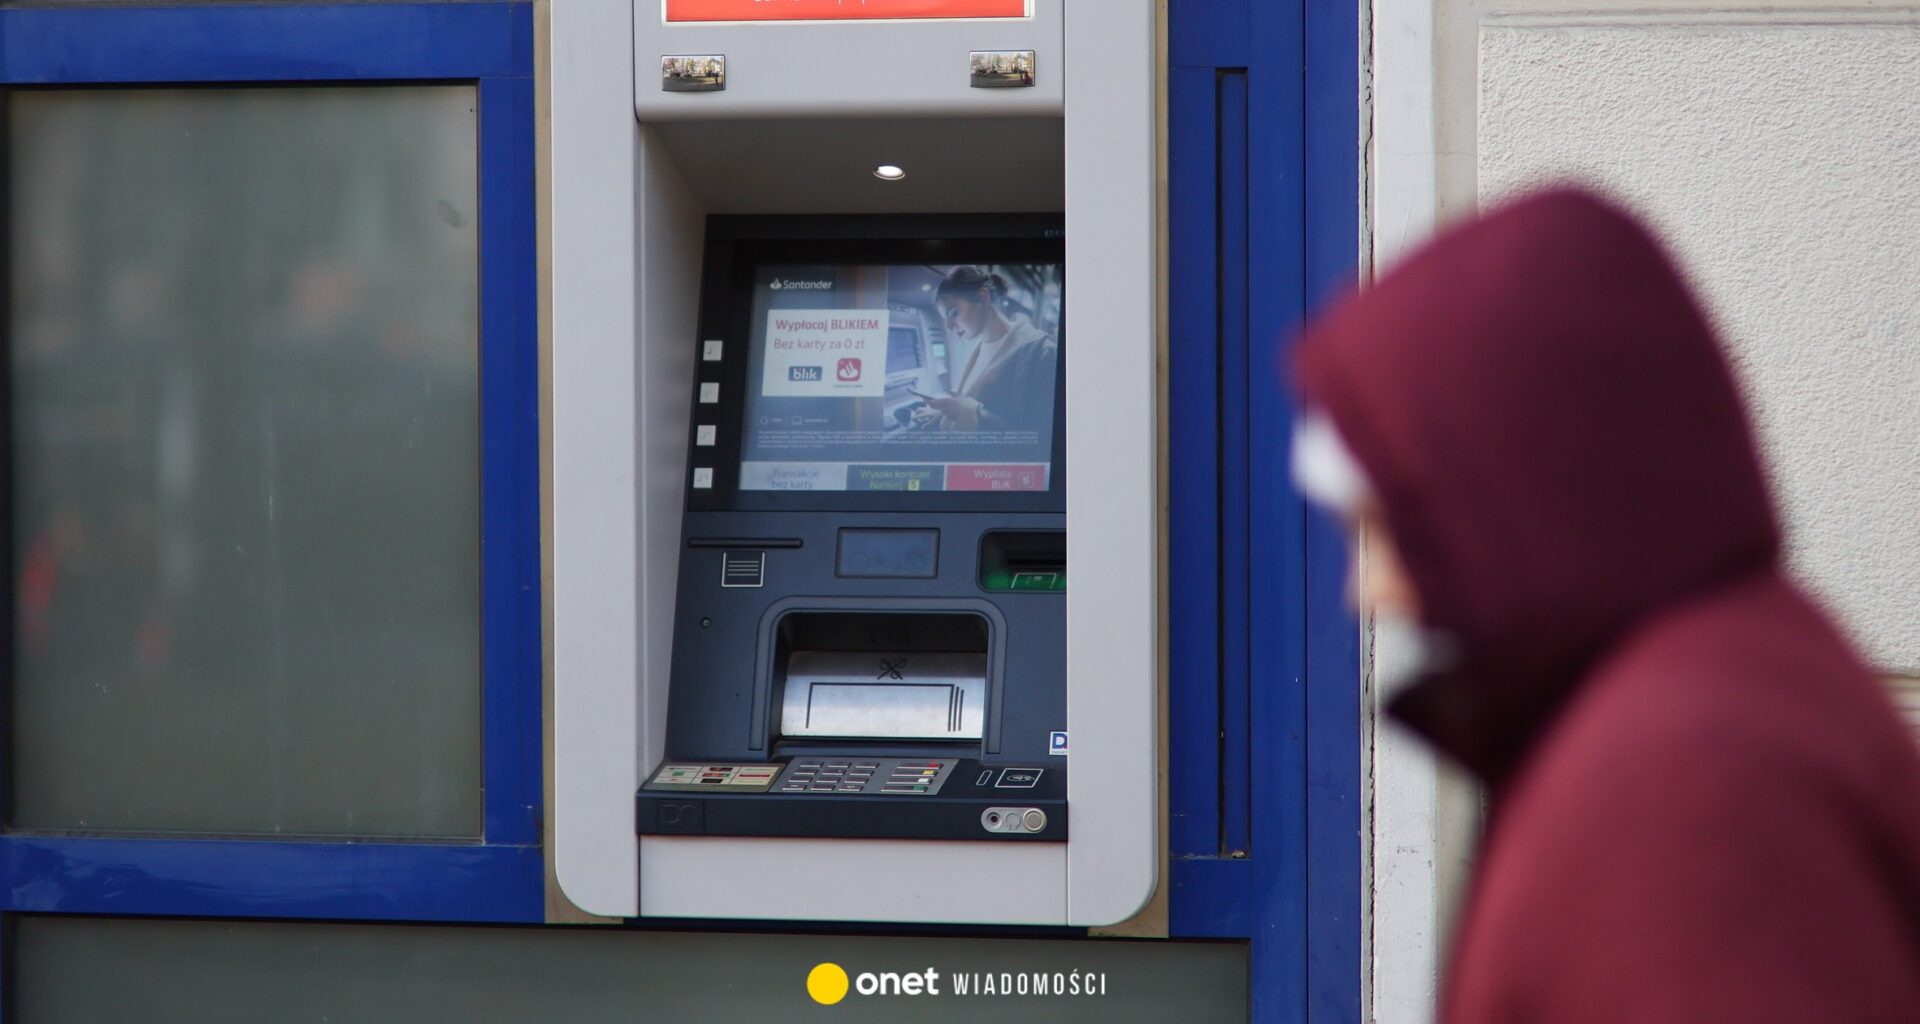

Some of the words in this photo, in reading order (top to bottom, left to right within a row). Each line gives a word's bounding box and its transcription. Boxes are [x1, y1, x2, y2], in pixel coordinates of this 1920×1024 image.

[783, 280, 832, 289] Santander
[775, 319, 828, 332] Wypłacaj
[831, 319, 879, 330] BLIKIEM
[774, 338, 794, 349] Bez
[797, 338, 825, 352] karty
[828, 341, 841, 349] za
[844, 339, 852, 349] 0
[855, 339, 864, 349] zł
[793, 368, 817, 380] blik
[861, 469, 892, 479] Wysoki
[974, 469, 1012, 480] Wypłata
[771, 480, 788, 489] bez
[790, 480, 814, 489] karty
[991, 480, 1011, 489] BLIK
